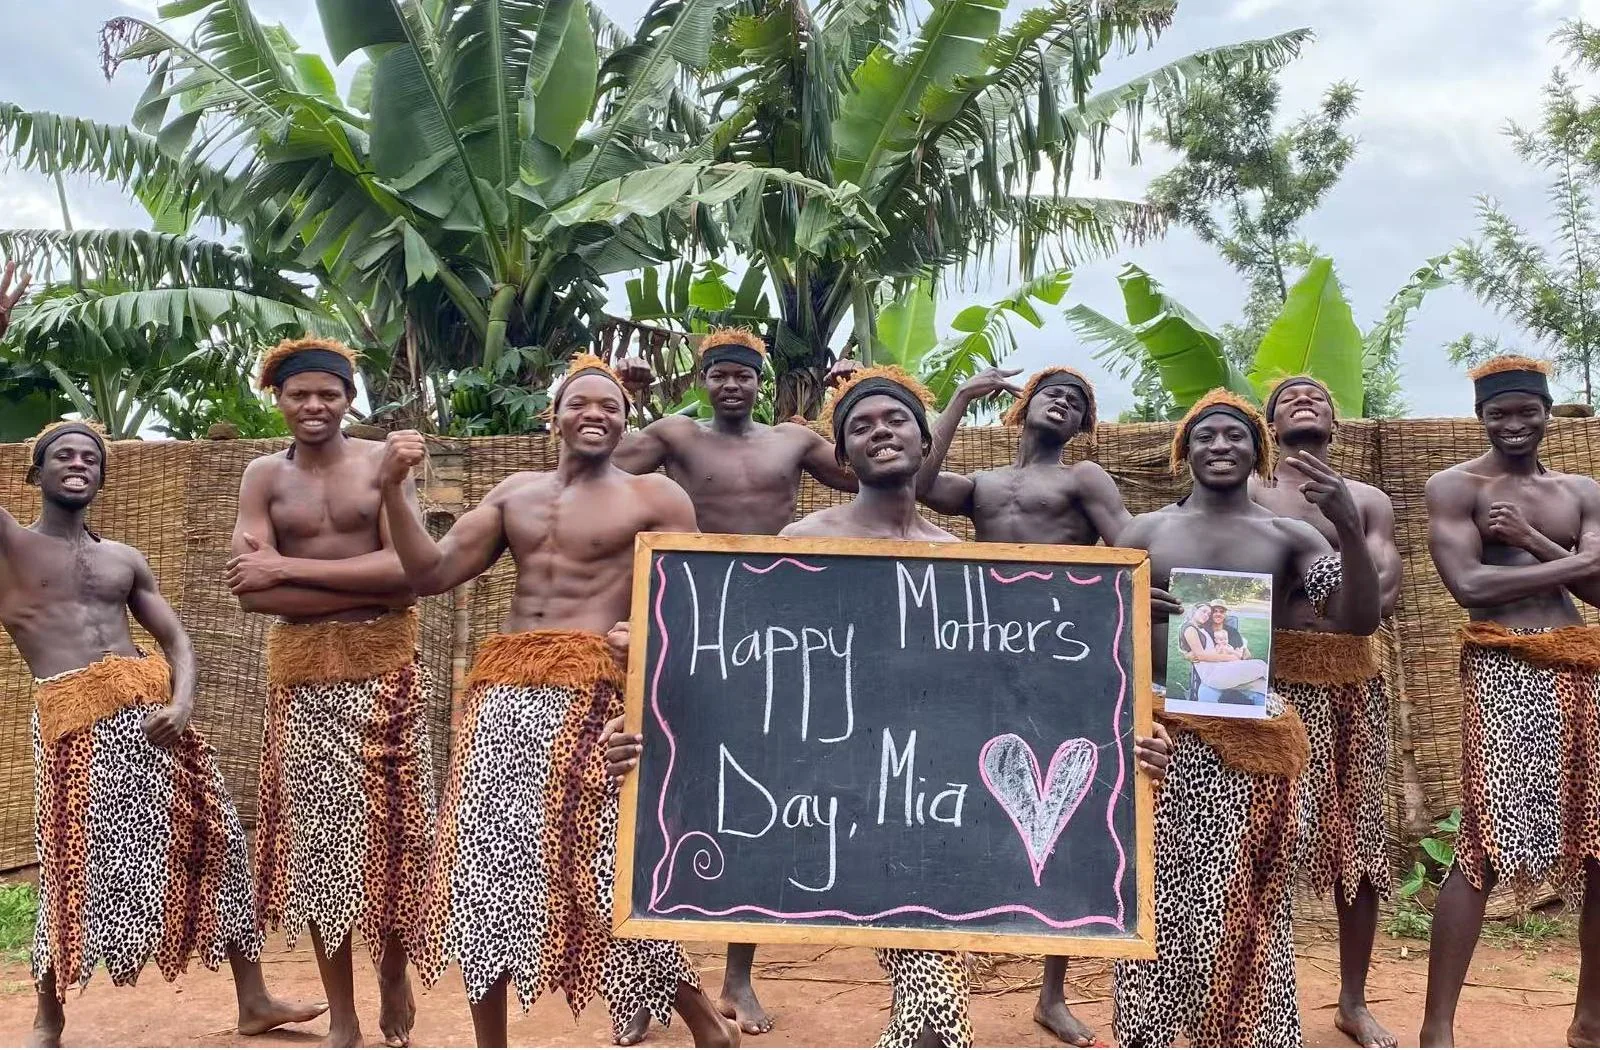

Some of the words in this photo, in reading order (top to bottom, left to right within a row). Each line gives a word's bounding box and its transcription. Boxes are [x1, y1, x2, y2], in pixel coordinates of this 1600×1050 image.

[683, 560, 855, 743] Happy
[896, 561, 1091, 661] Mother's
[717, 743, 858, 892] Day,
[877, 727, 968, 828] Mia
